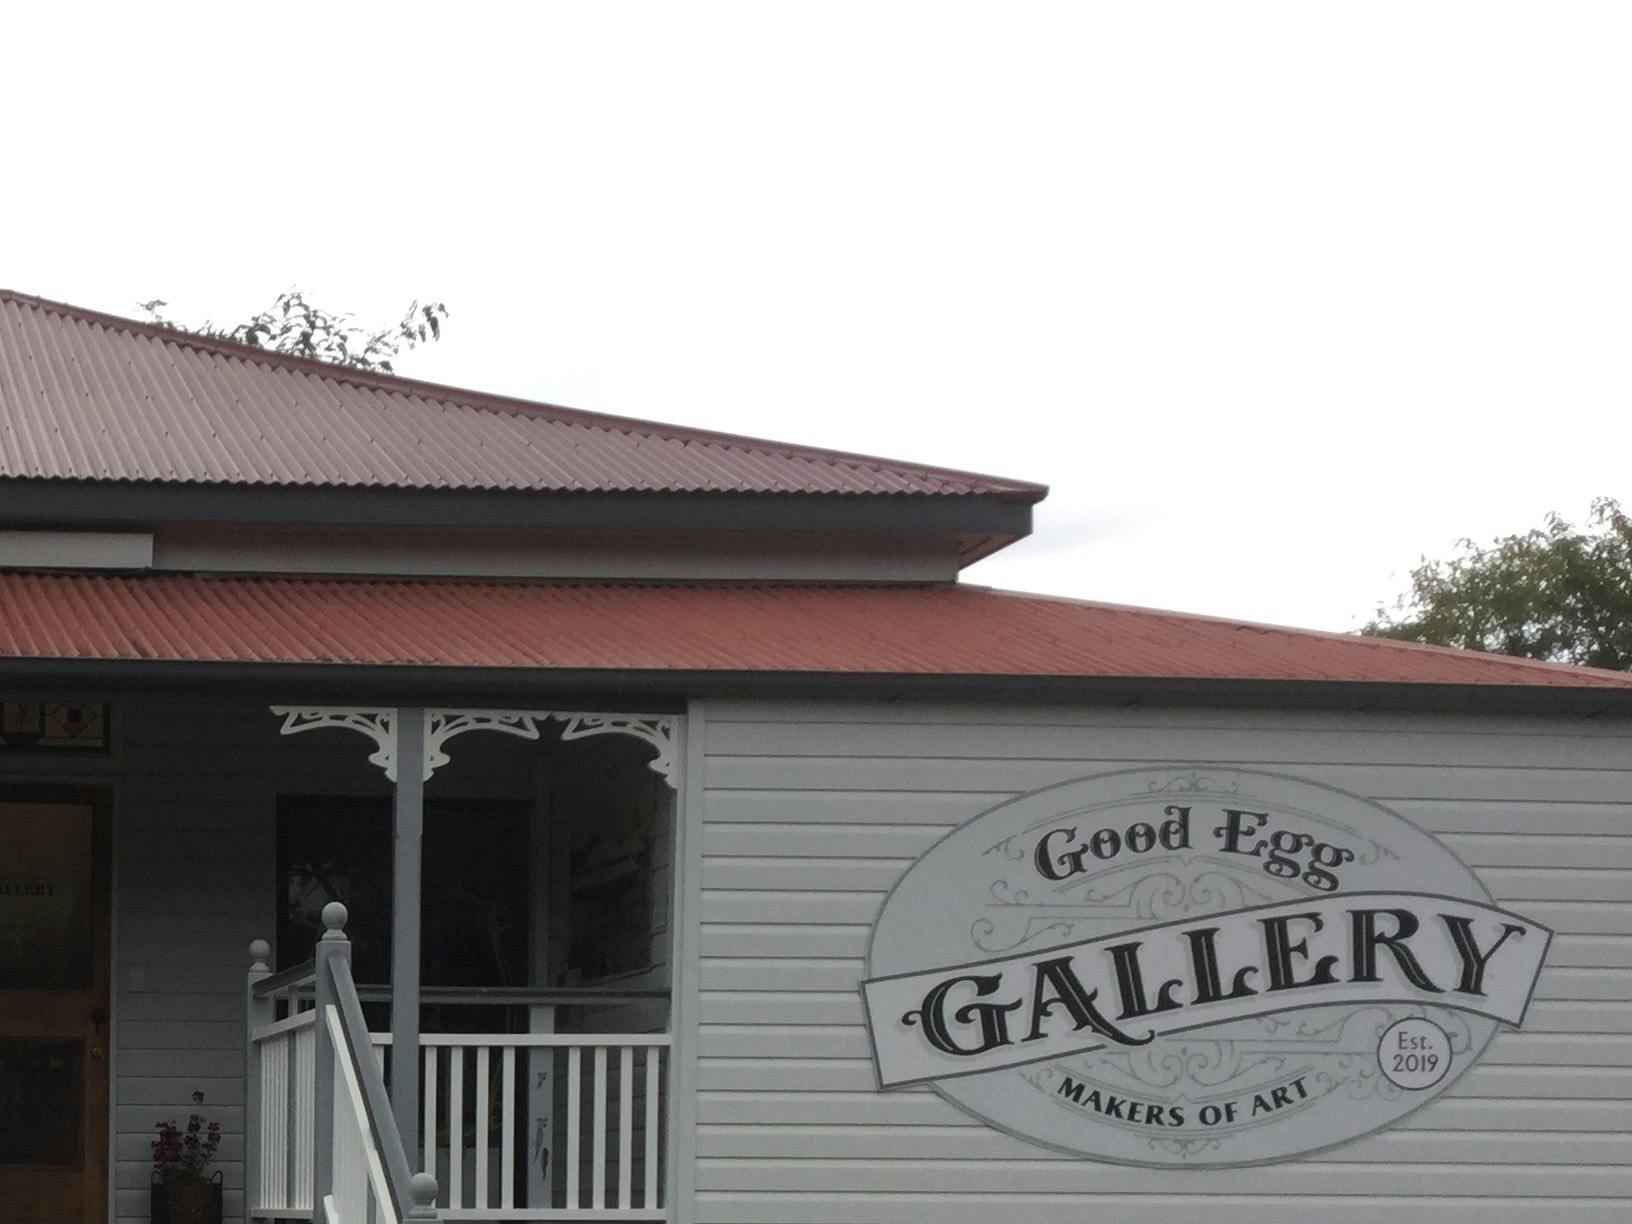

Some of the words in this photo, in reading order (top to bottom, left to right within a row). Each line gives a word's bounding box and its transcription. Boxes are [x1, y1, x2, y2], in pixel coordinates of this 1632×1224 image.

[1033, 805, 1192, 881] Good
[1212, 808, 1355, 892] Egg
[900, 908, 1527, 1057] GALLERY
[1392, 1053, 1440, 1074] 2019
[1397, 1030, 1435, 1051] Est.
[1056, 1076, 1185, 1127] MAKERS
[1199, 1101, 1240, 1127] OF
[1251, 1077, 1311, 1116] ART
